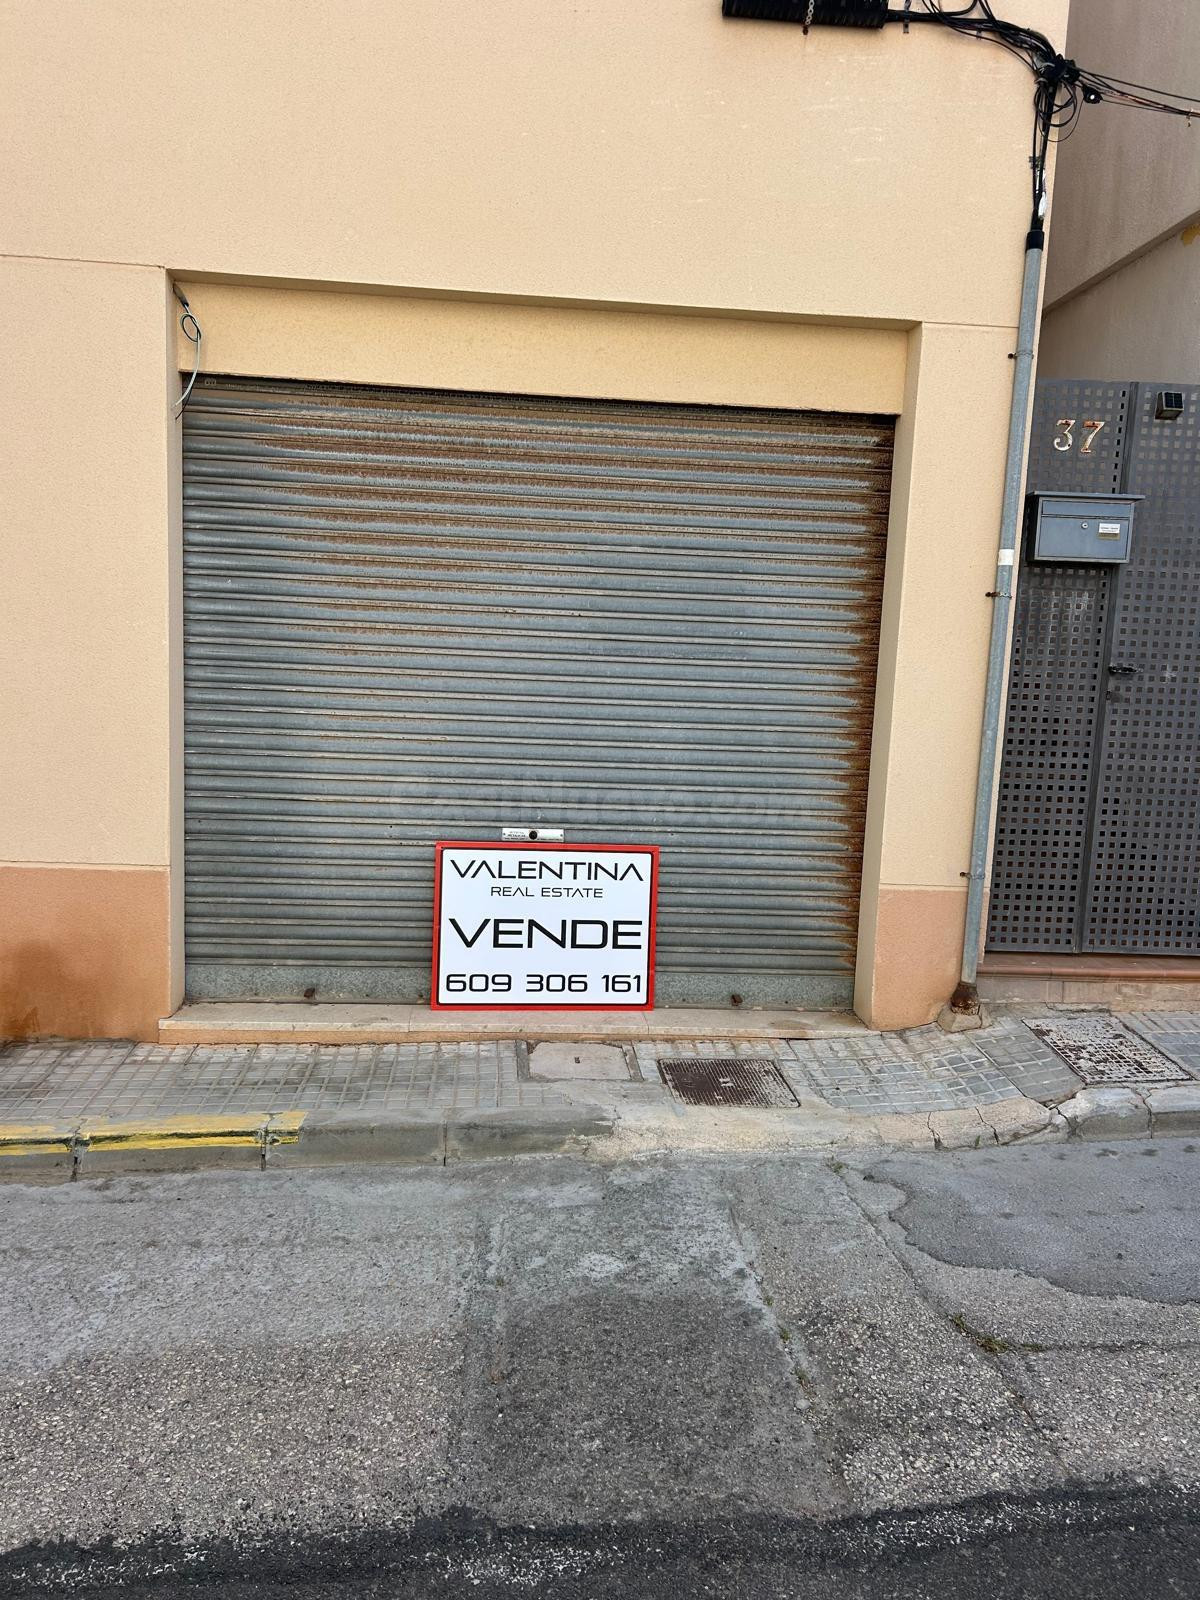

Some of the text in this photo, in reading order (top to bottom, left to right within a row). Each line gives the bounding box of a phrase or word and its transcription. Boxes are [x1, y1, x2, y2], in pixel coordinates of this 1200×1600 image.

[1053, 419, 1105, 453] 37
[450, 859, 644, 881] VALENTINA
[490, 886, 603, 898] REAL ESTATE
[448, 918, 643, 950] VENDE
[446, 973, 641, 993] 609 306 161
